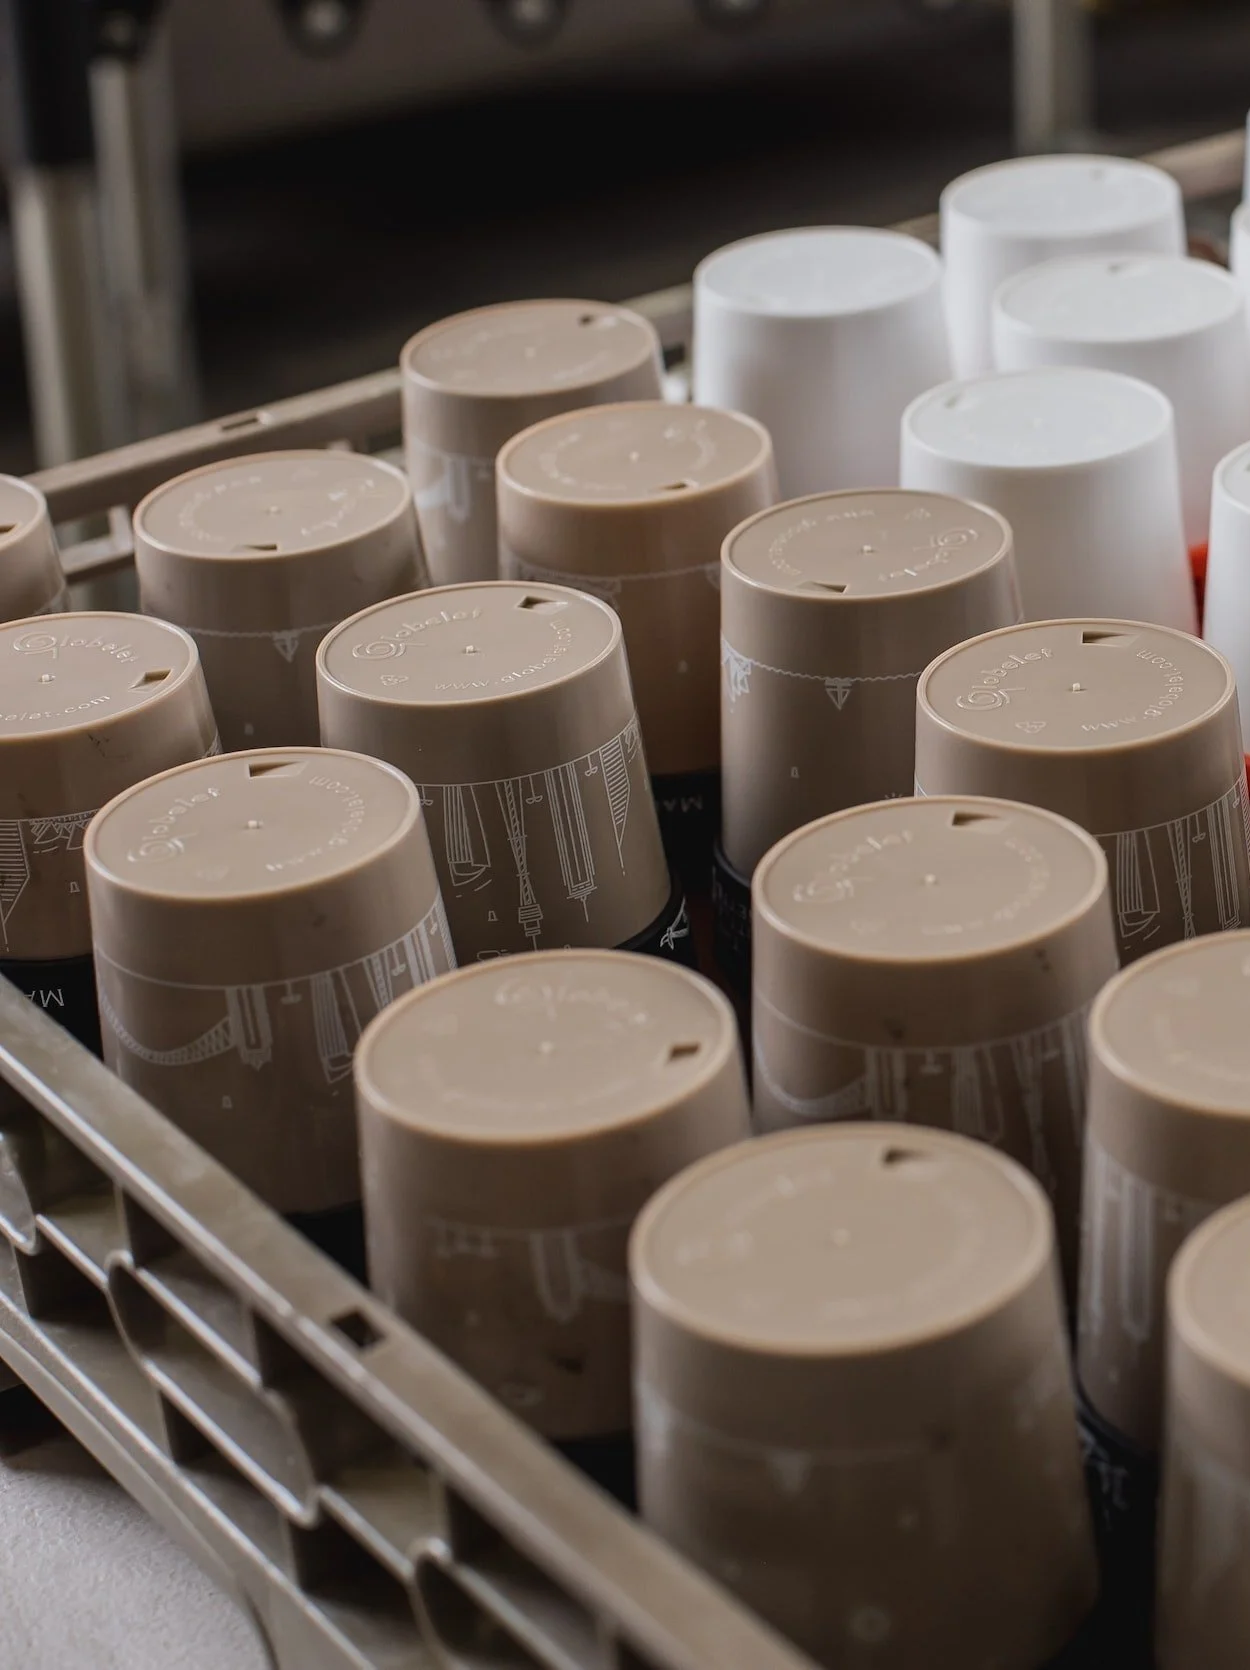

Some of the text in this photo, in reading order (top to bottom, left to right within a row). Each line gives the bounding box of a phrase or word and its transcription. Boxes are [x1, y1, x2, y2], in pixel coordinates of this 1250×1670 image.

[13, 632, 138, 663] Globelet
[352, 606, 482, 660] Globelet
[955, 647, 1053, 712] Globelet
[1080, 648, 1184, 734] www.globelet.com
